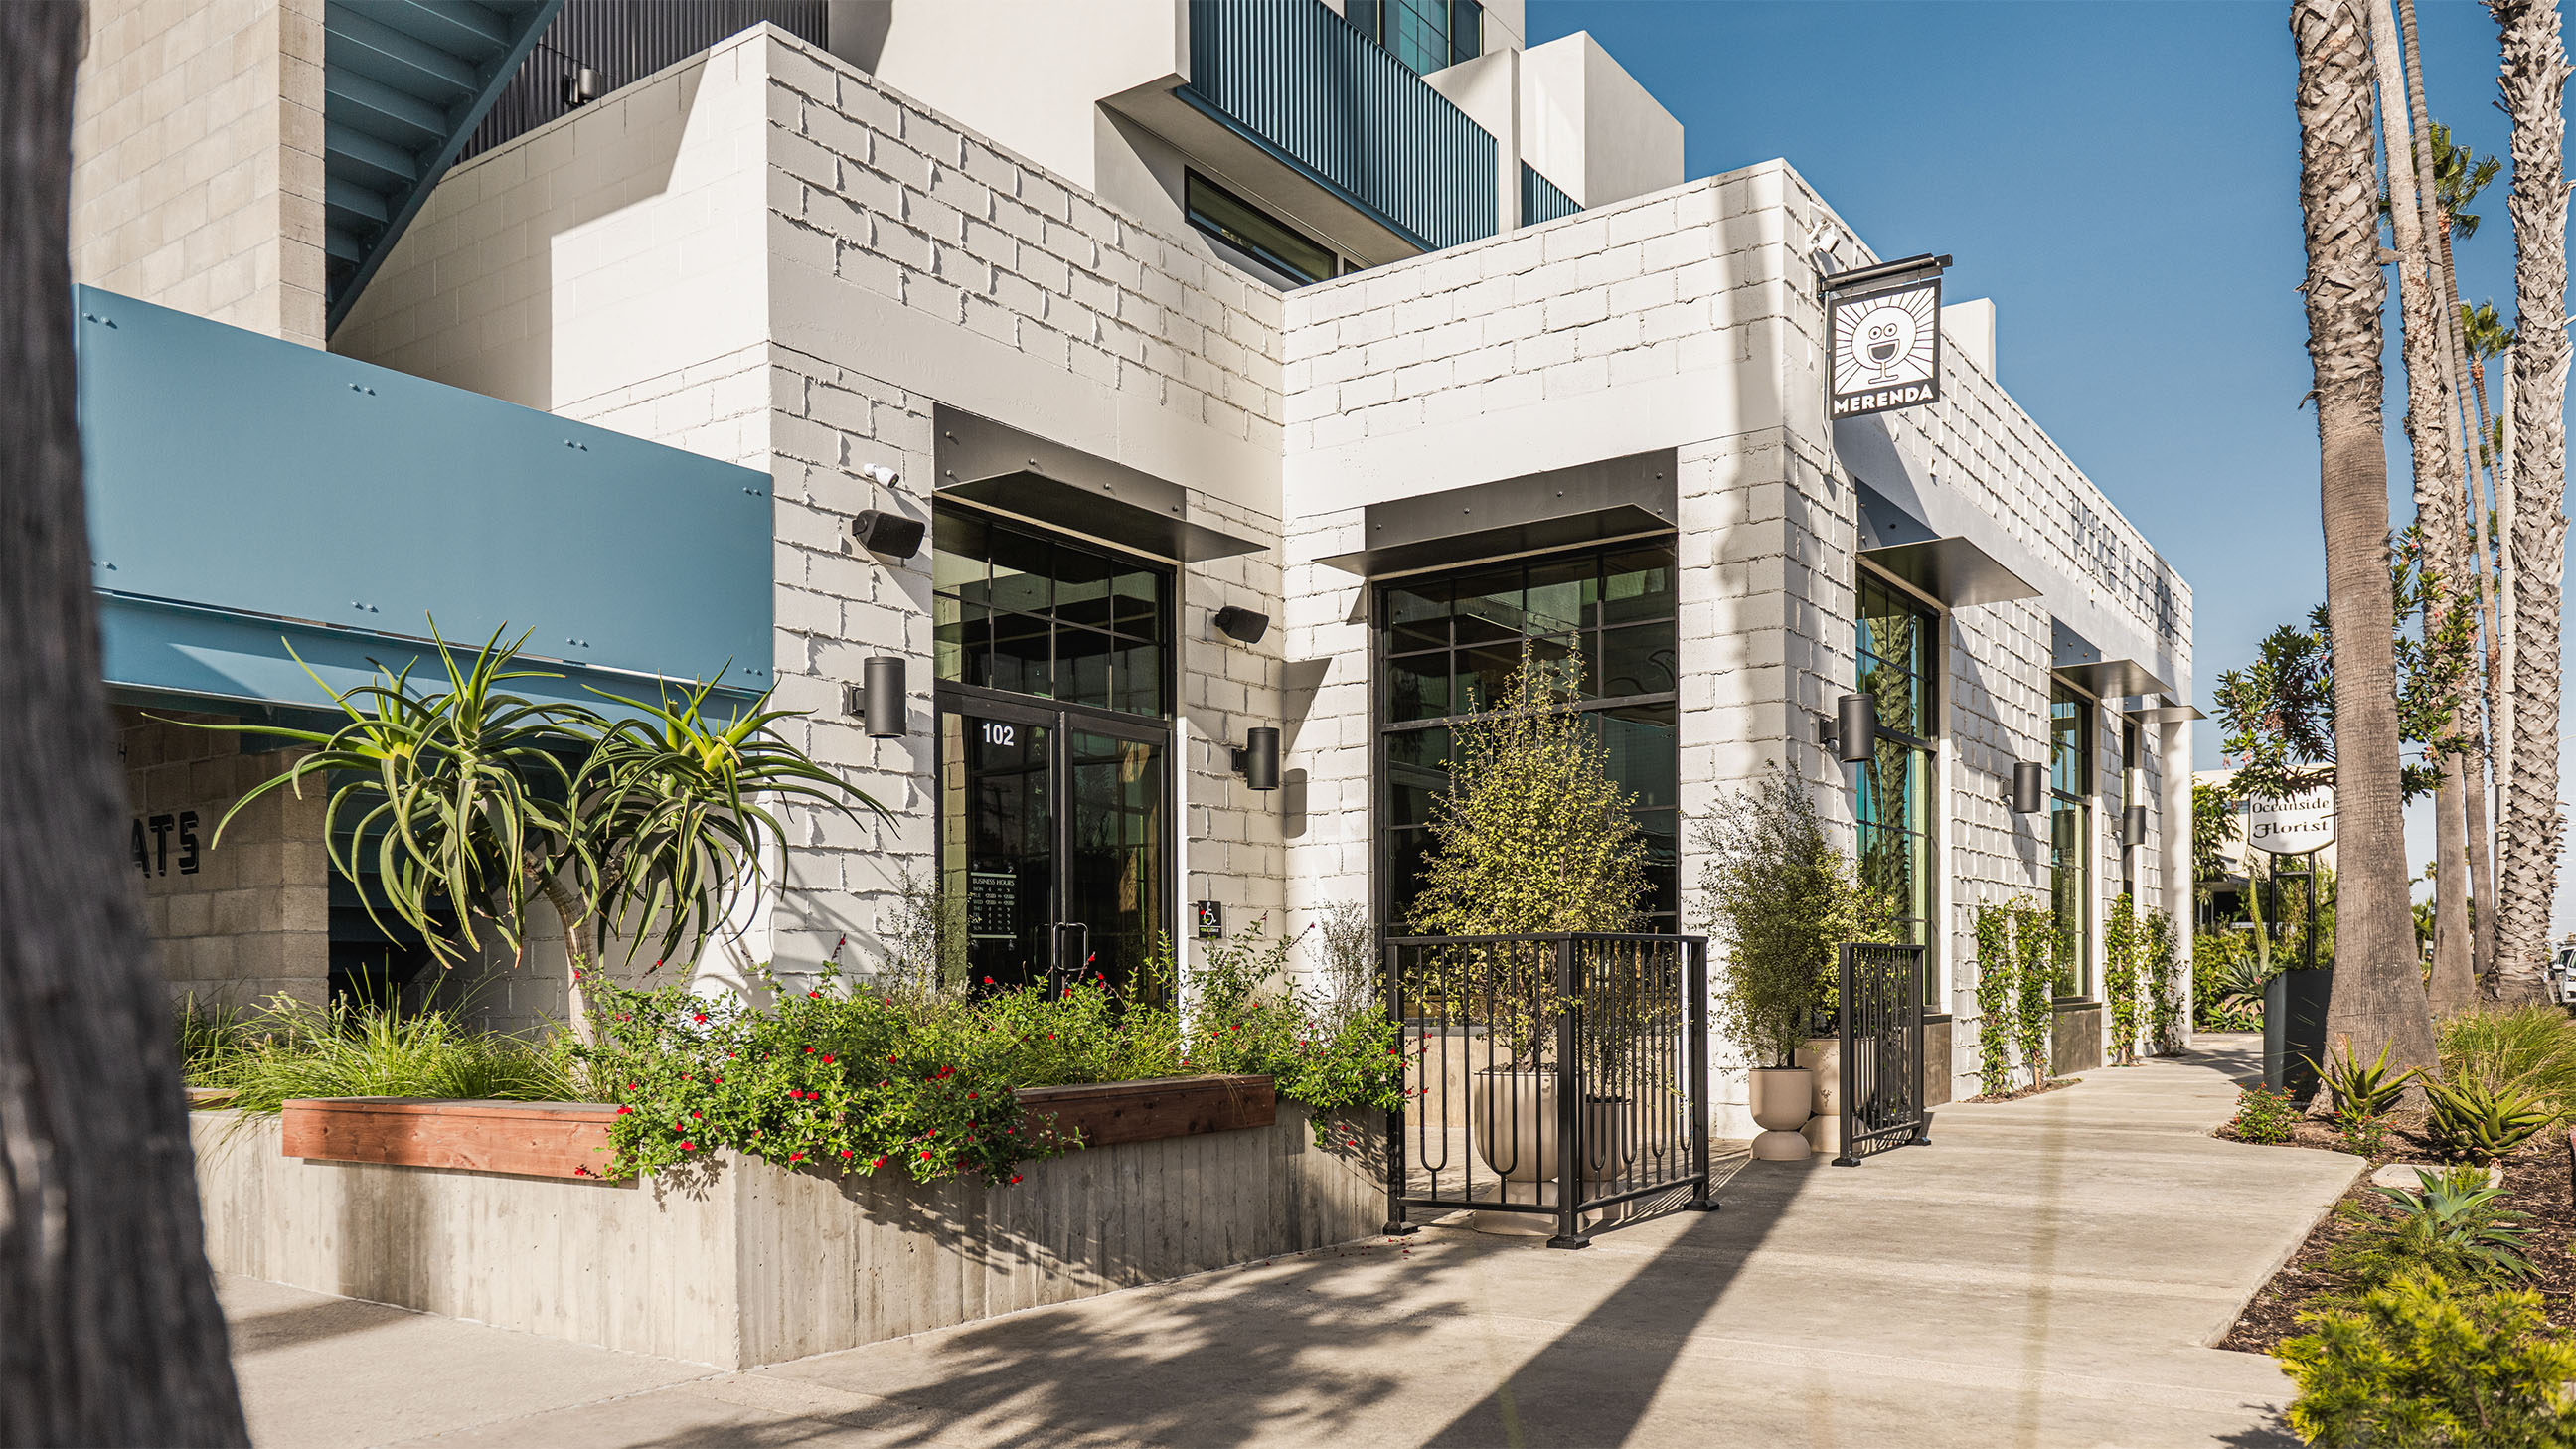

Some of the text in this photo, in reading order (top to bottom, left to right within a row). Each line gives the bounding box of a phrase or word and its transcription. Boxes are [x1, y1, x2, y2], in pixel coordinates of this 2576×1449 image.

[1834, 383, 1934, 414] MERENDA
[983, 723, 1015, 746] 102
[2252, 797, 2330, 814] Oceanside
[2253, 821, 2330, 838] Florist
[131, 810, 200, 878] ATS
